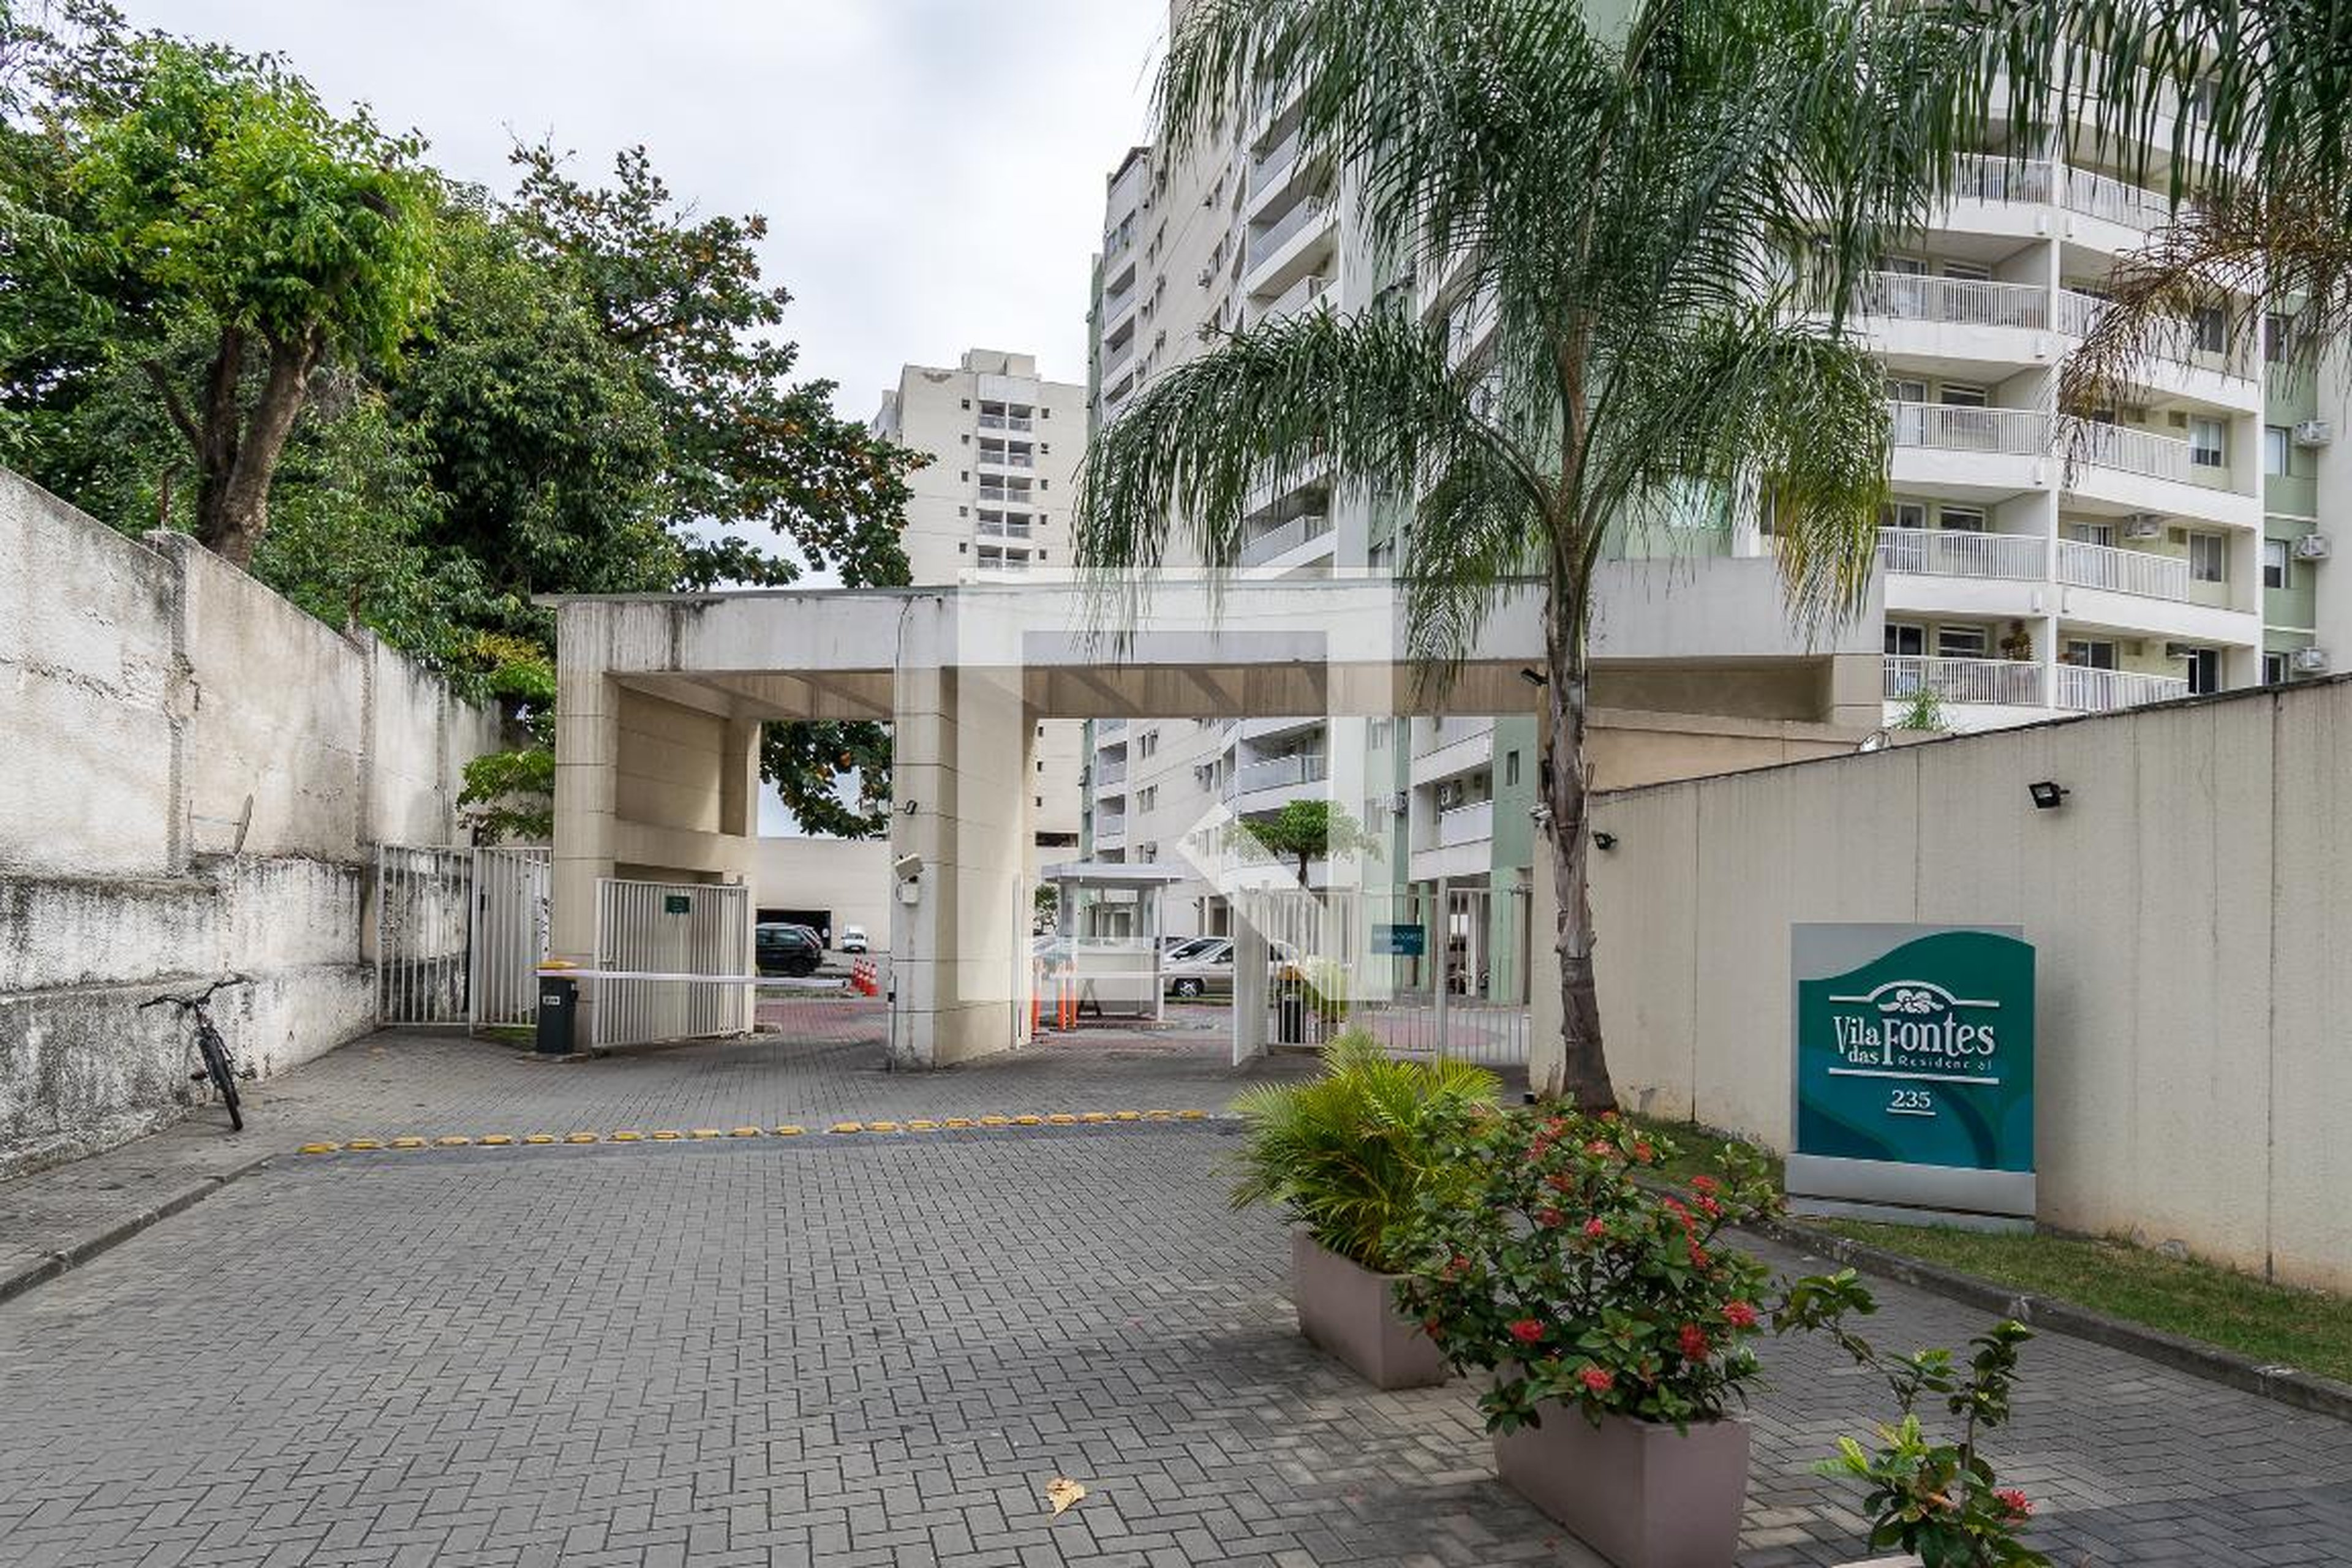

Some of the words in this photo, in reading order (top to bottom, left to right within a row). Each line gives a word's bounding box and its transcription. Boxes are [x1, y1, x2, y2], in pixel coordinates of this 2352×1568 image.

[1833, 1016, 1881, 1054] Vila
[1882, 1012, 1996, 1065] Fontes
[1849, 1045, 1879, 1065] das
[1898, 1055, 1992, 1071] Residencal
[1891, 1089, 1931, 1108] 235
